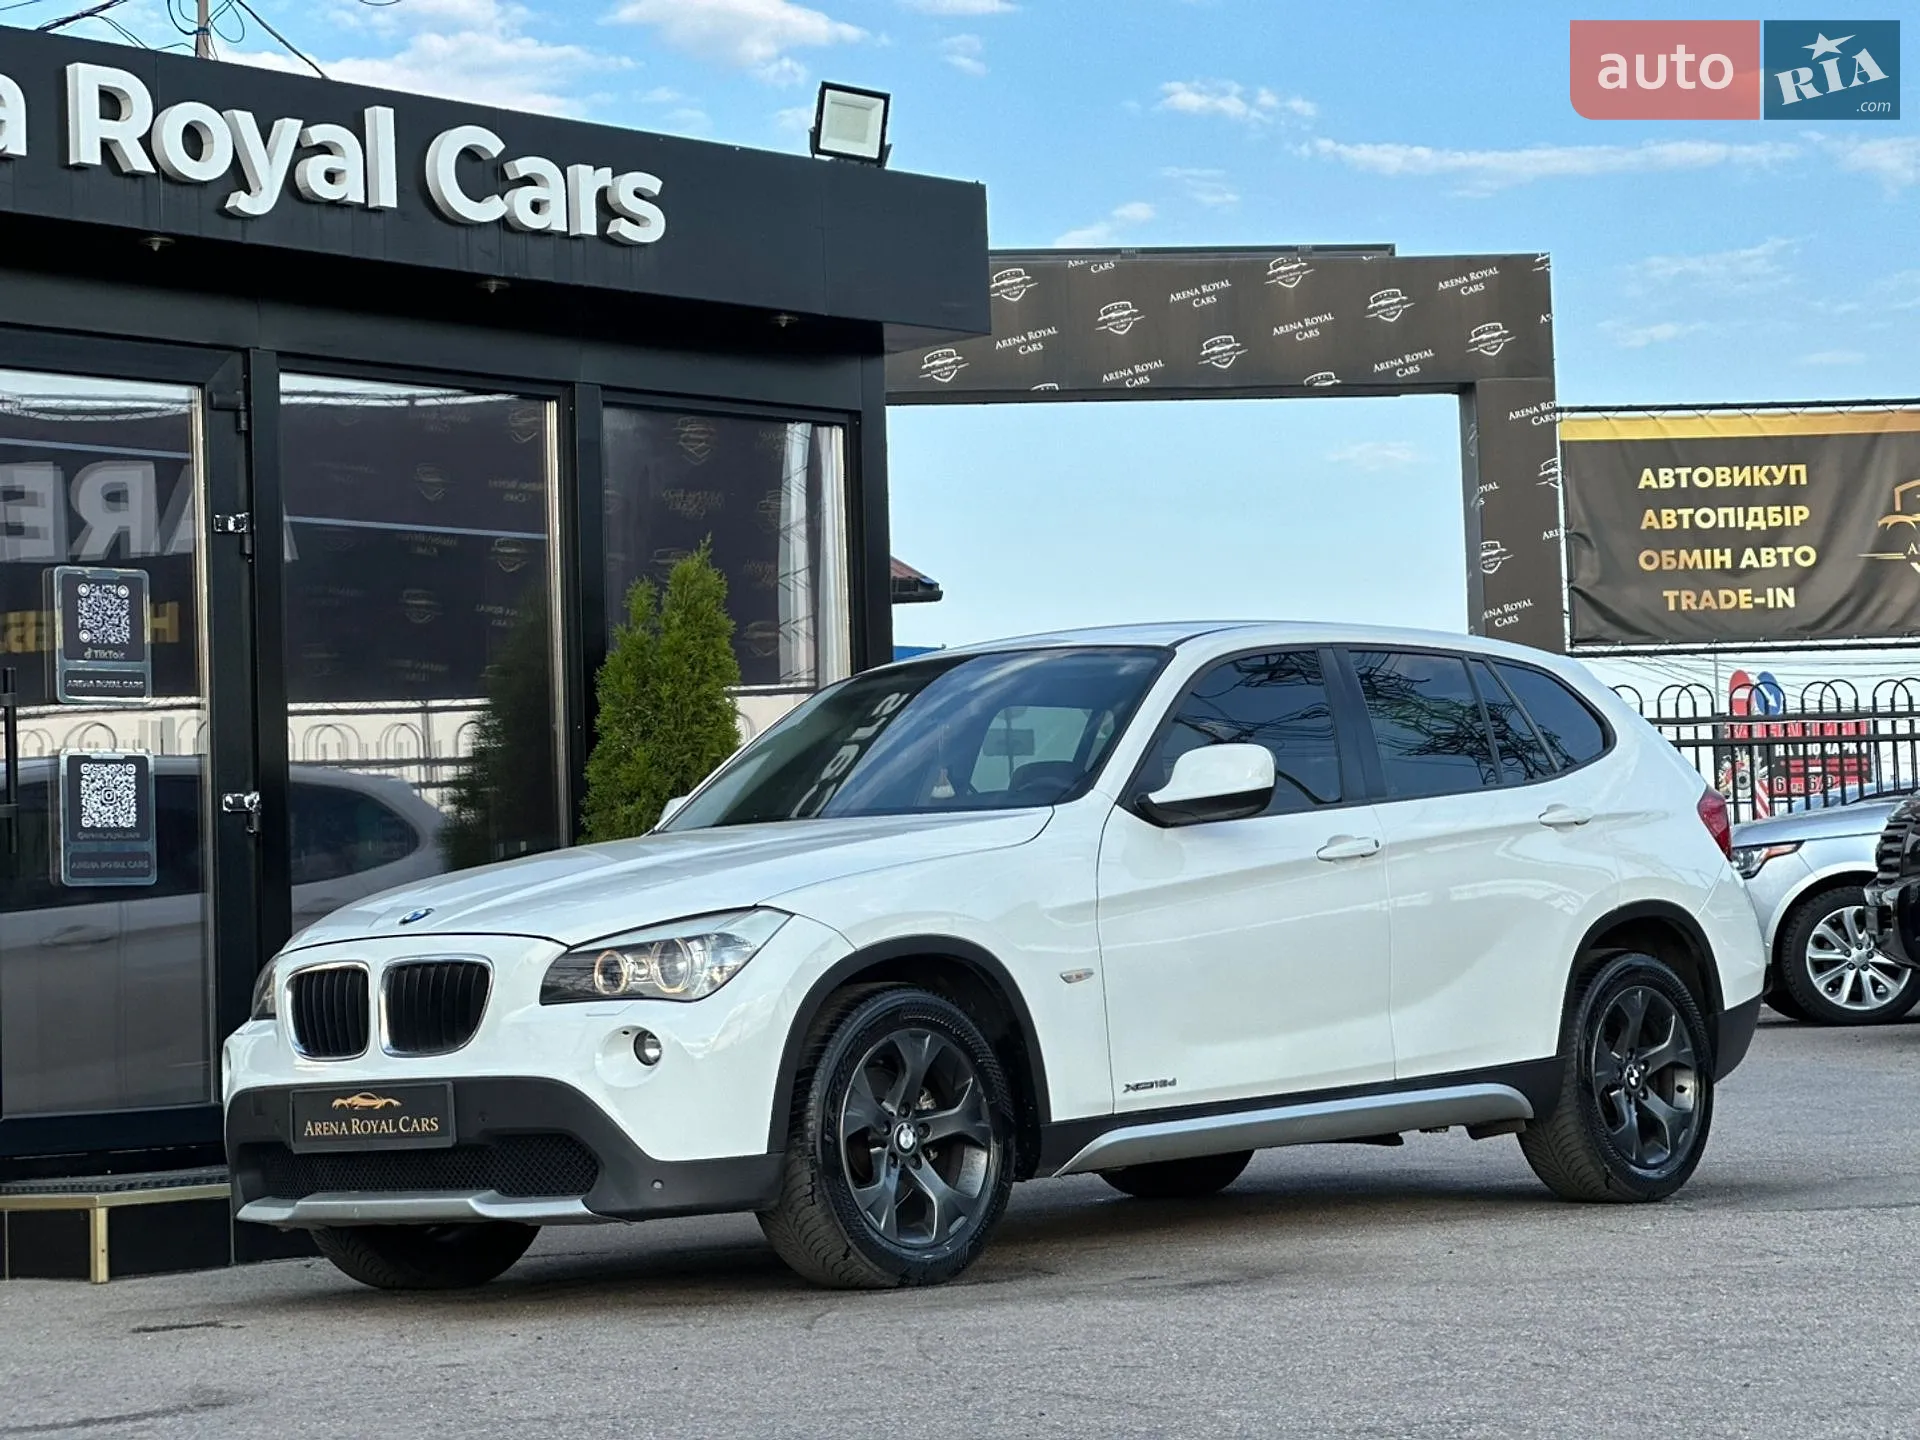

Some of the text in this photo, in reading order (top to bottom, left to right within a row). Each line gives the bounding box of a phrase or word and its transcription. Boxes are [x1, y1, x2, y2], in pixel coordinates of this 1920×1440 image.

[66, 62, 397, 217] Royal
[425, 125, 666, 245] Cars
[1438, 266, 1500, 291] ARENA ROYAL
[1459, 282, 1485, 295] CARS
[1169, 279, 1232, 303] ARENA ROYAL
[1192, 294, 1217, 307] CARS
[1272, 312, 1335, 336] ARENA ROYAL
[1295, 328, 1320, 341] CARS
[995, 326, 1058, 350] ARENA ROYAL
[1018, 342, 1044, 355] CARS
[1102, 358, 1165, 383] ARENA ROYAL
[1373, 349, 1435, 373] ARENA ROYAL
[1395, 364, 1421, 377] CARS
[1125, 374, 1150, 388] CARS
[1509, 405, 1539, 421] ARENA
[1638, 464, 1808, 490] АВТОВИКУП
[1640, 505, 1810, 531] АВТОПІДБІР
[1638, 545, 1817, 571] ОБМІН АВТО
[1503, 598, 1533, 614] ROYAL
[1663, 587, 1796, 611] TRADE-IN
[1494, 614, 1519, 627] CARS
[304, 1115, 439, 1136] ARENA ROYAL CARS
